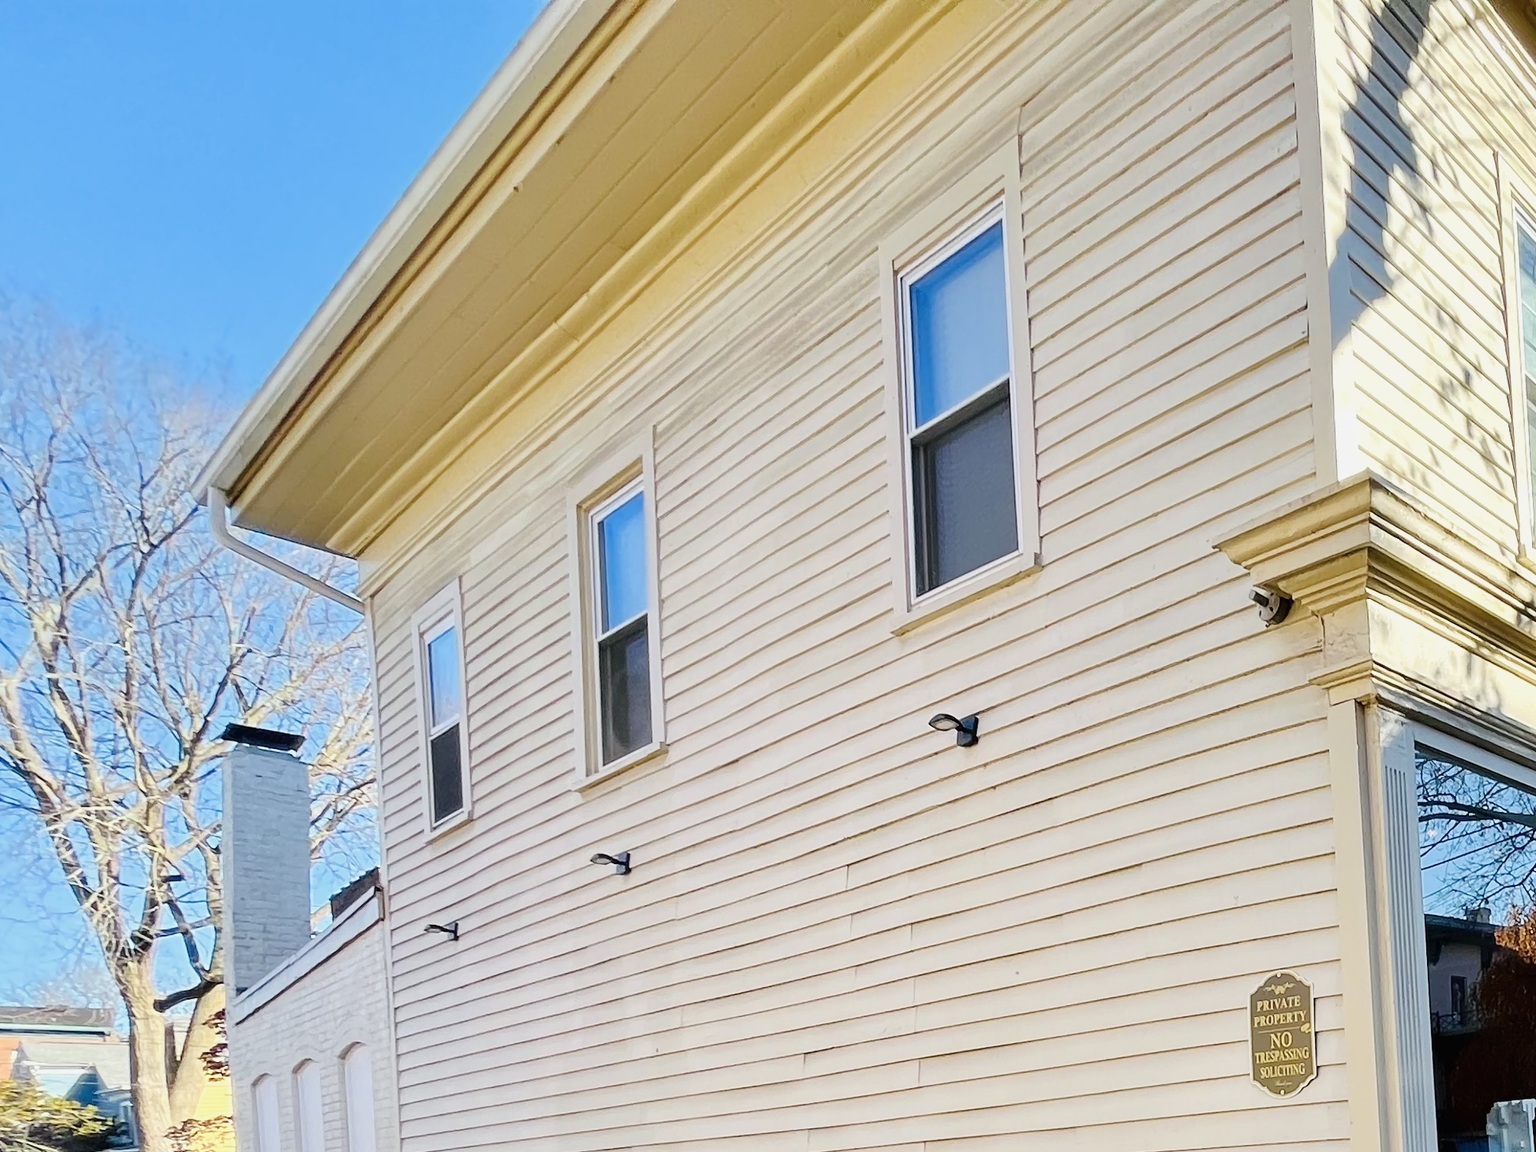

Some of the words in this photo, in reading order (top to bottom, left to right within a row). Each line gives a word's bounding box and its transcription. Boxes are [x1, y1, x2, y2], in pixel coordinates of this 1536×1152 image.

[1256, 995, 1301, 1012] PRIVATE
[1253, 1010, 1307, 1028] PROPERTY
[1270, 1031, 1293, 1049] NO
[1254, 1046, 1310, 1064] TRESPASSING
[1259, 1062, 1306, 1080] SOLICITING
